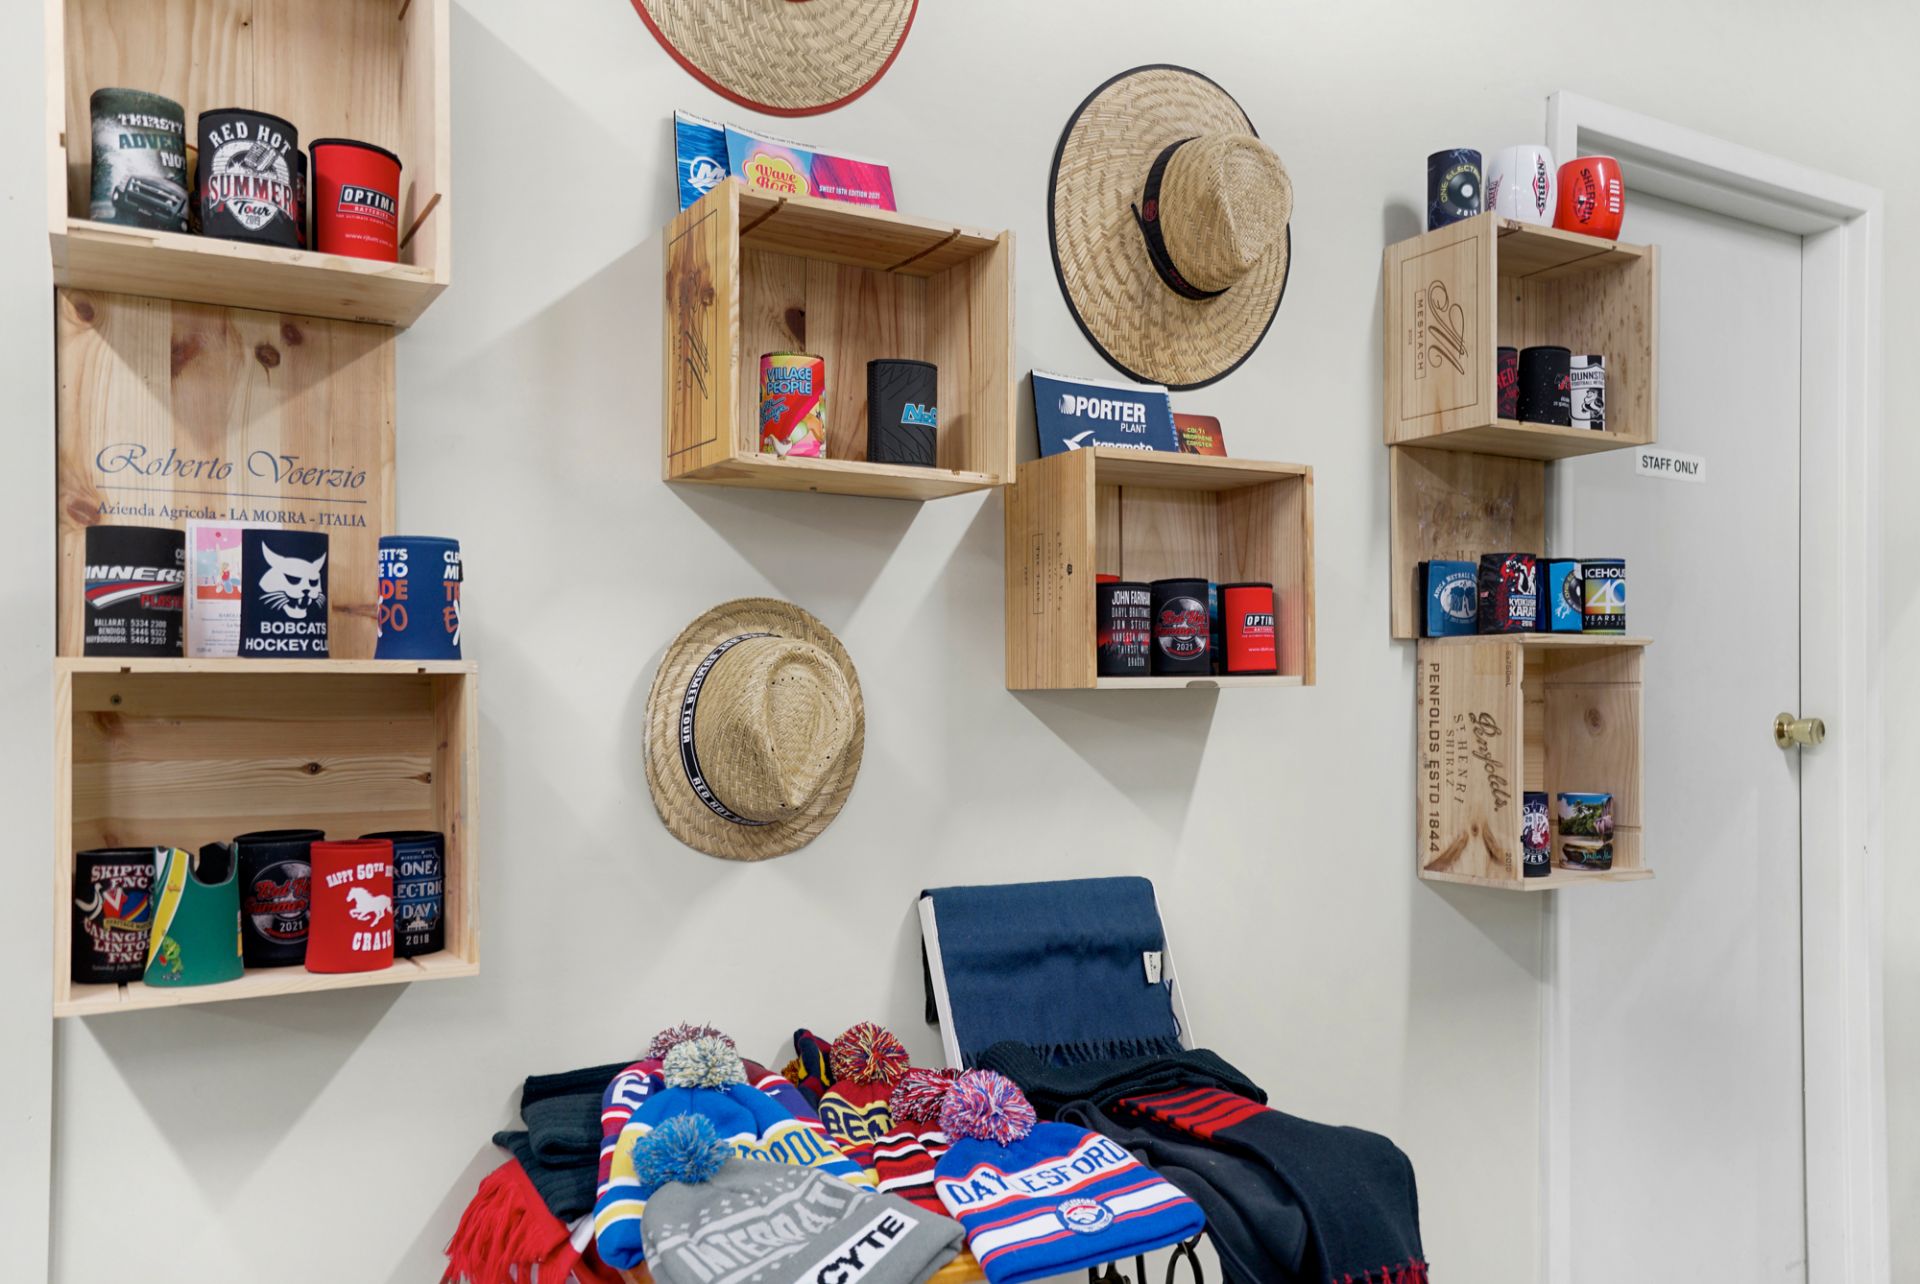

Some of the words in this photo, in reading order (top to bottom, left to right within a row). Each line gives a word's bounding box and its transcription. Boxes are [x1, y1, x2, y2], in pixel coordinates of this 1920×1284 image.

[209, 121, 249, 149] RED
[258, 124, 292, 156] HOT
[755, 164, 798, 183] Wave
[849, 189, 868, 199] EDITION
[1537, 162, 1546, 209] STEEDEN
[208, 174, 294, 220] SUMMER
[343, 187, 395, 214] OPTIMA
[1580, 167, 1597, 225] SHERRIN
[233, 201, 272, 217] Tour
[1416, 299, 1425, 371] MESHACH
[767, 367, 812, 381] VILLAGE
[767, 381, 812, 396] PEOPLE
[1076, 398, 1146, 424] PORTER
[1121, 422, 1147, 434] PLANT
[96, 442, 233, 480] Roberto
[248, 450, 367, 489] Voerzio
[1642, 455, 1672, 472] STAFF
[1674, 459, 1699, 475] ONLY
[97, 501, 155, 518] Azienda
[159, 508, 217, 522] Agricola
[230, 508, 249, 522] LA
[253, 510, 306, 525] MORRA
[319, 513, 367, 528] ITALIA
[388, 562, 409, 578] 10
[1111, 590, 1129, 606] JOHN
[1585, 578, 1626, 614] 40
[260, 621, 327, 635] BOBCATS
[245, 637, 309, 652] HOCKEY
[1176, 642, 1193, 651] 2021
[686, 652, 720, 704] SUMMER
[1429, 663, 1440, 753] PENFOLDS
[682, 709, 693, 744] TOUR
[1445, 729, 1455, 787] SHIRAZ
[692, 777, 710, 799] RED
[710, 801, 731, 817] HOT
[1429, 812, 1440, 853] 1844
[326, 868, 354, 888] HAPPY
[401, 860, 433, 876] ONE
[111, 876, 148, 889] FNC
[402, 902, 432, 919] DAY
[280, 920, 303, 932] 2021
